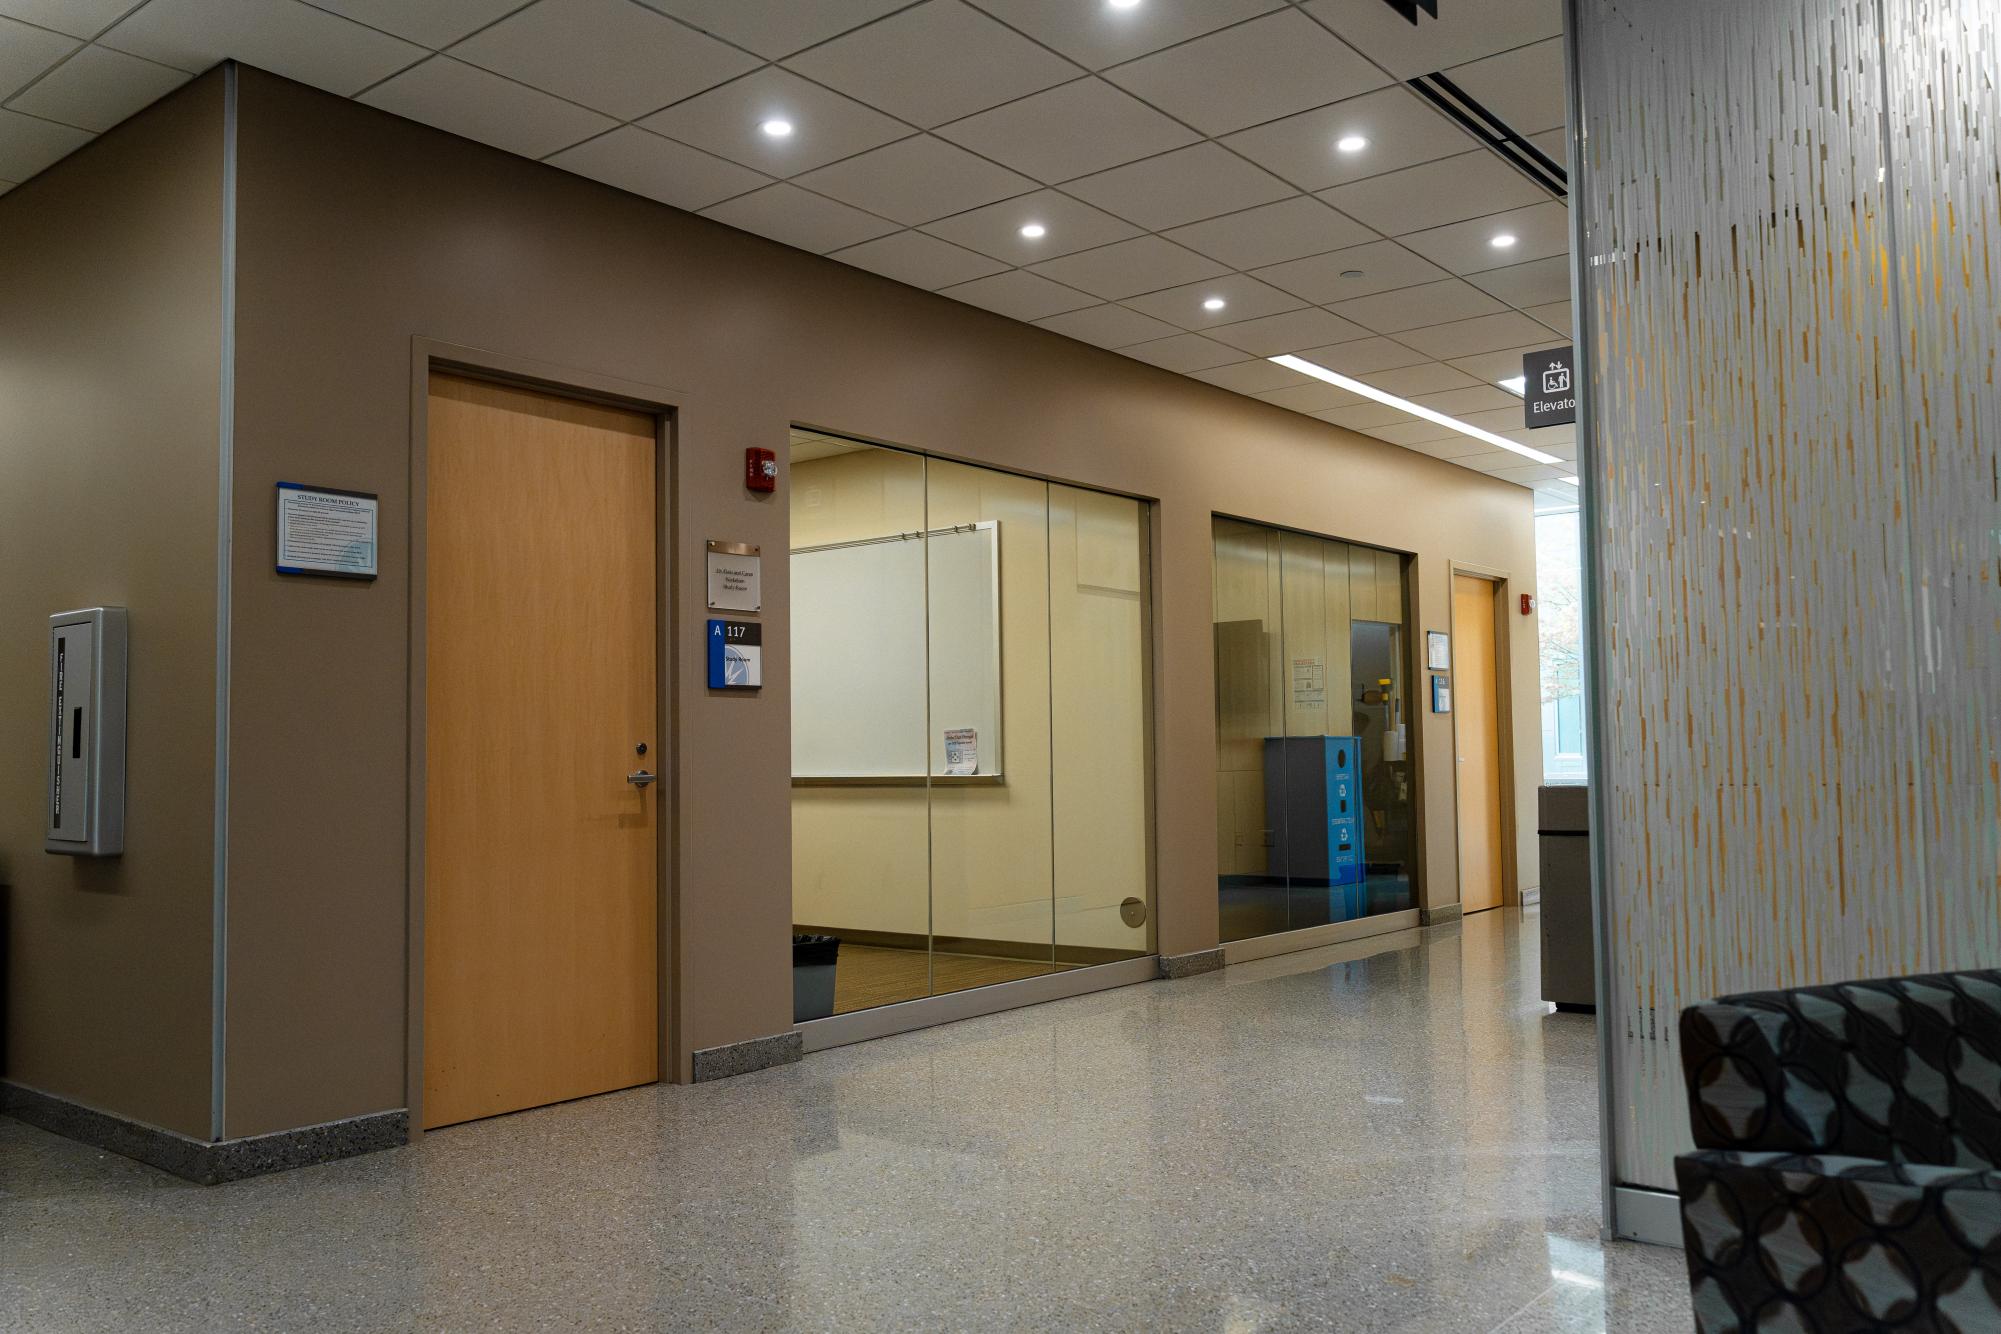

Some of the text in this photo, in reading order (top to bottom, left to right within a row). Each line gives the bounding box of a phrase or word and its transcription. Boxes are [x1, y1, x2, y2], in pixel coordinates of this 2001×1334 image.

[1533, 398, 1576, 413] Elevato
[714, 624, 746, 638] A 117
